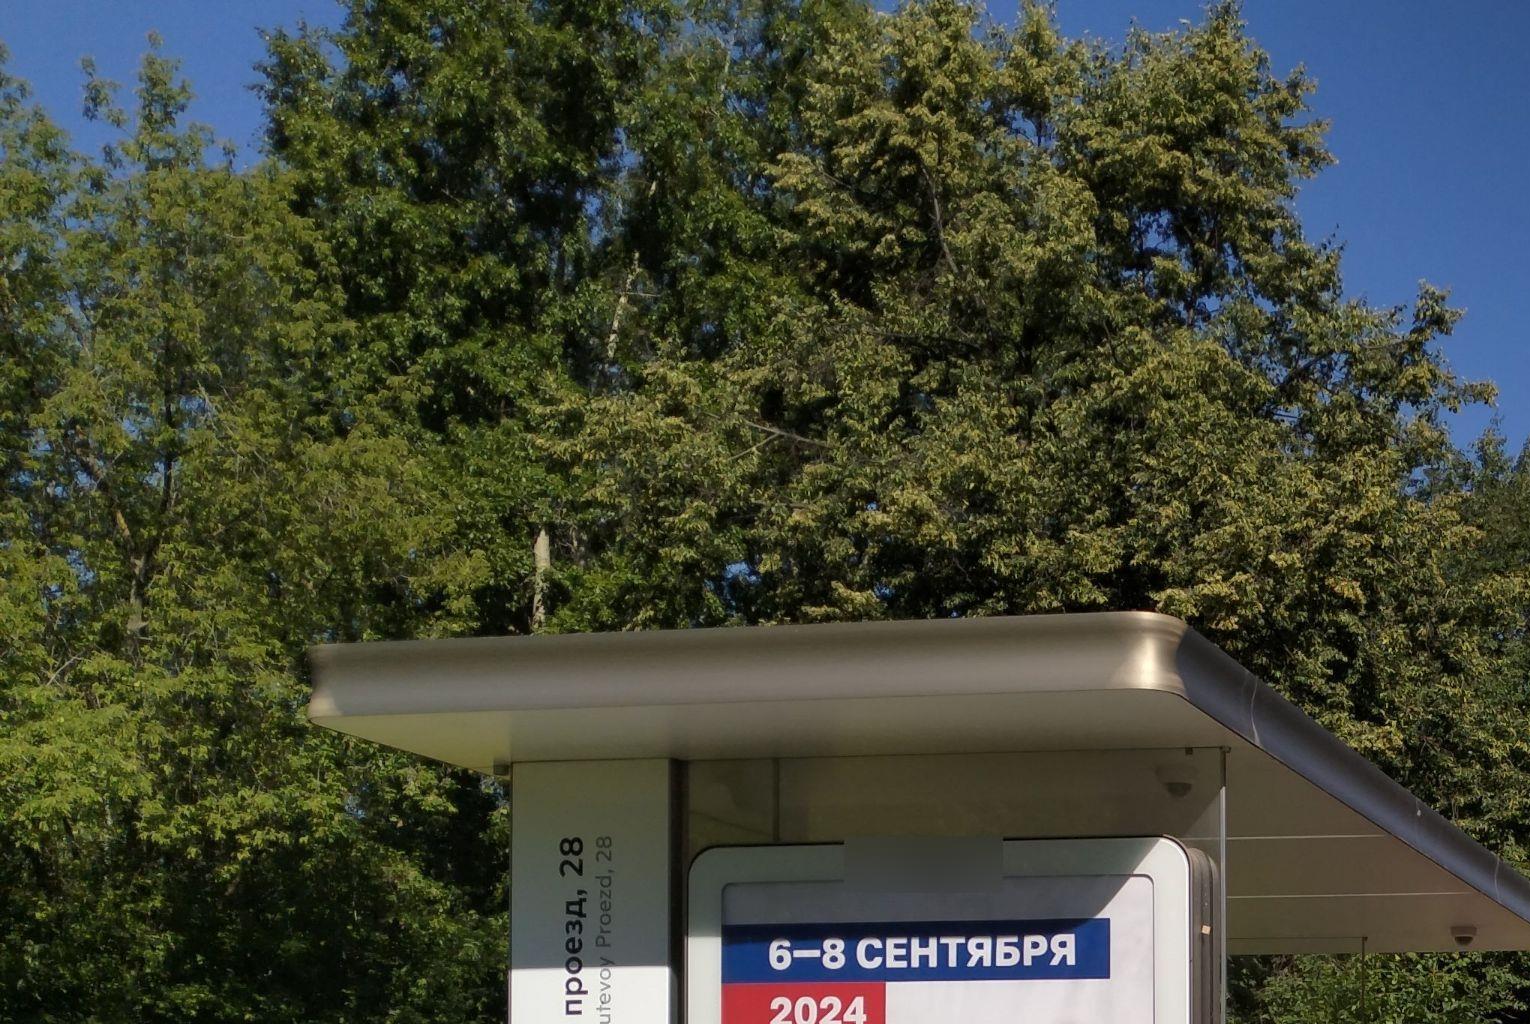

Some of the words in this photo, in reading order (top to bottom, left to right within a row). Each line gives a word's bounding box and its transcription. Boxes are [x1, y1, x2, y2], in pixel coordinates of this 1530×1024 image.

[558, 836, 584, 878] 28
[595, 835, 613, 862] 28
[595, 868, 614, 949] Proezd,
[564, 889, 588, 1016] проезд,
[855, 933, 1077, 969] СЕНТЯБРЯ
